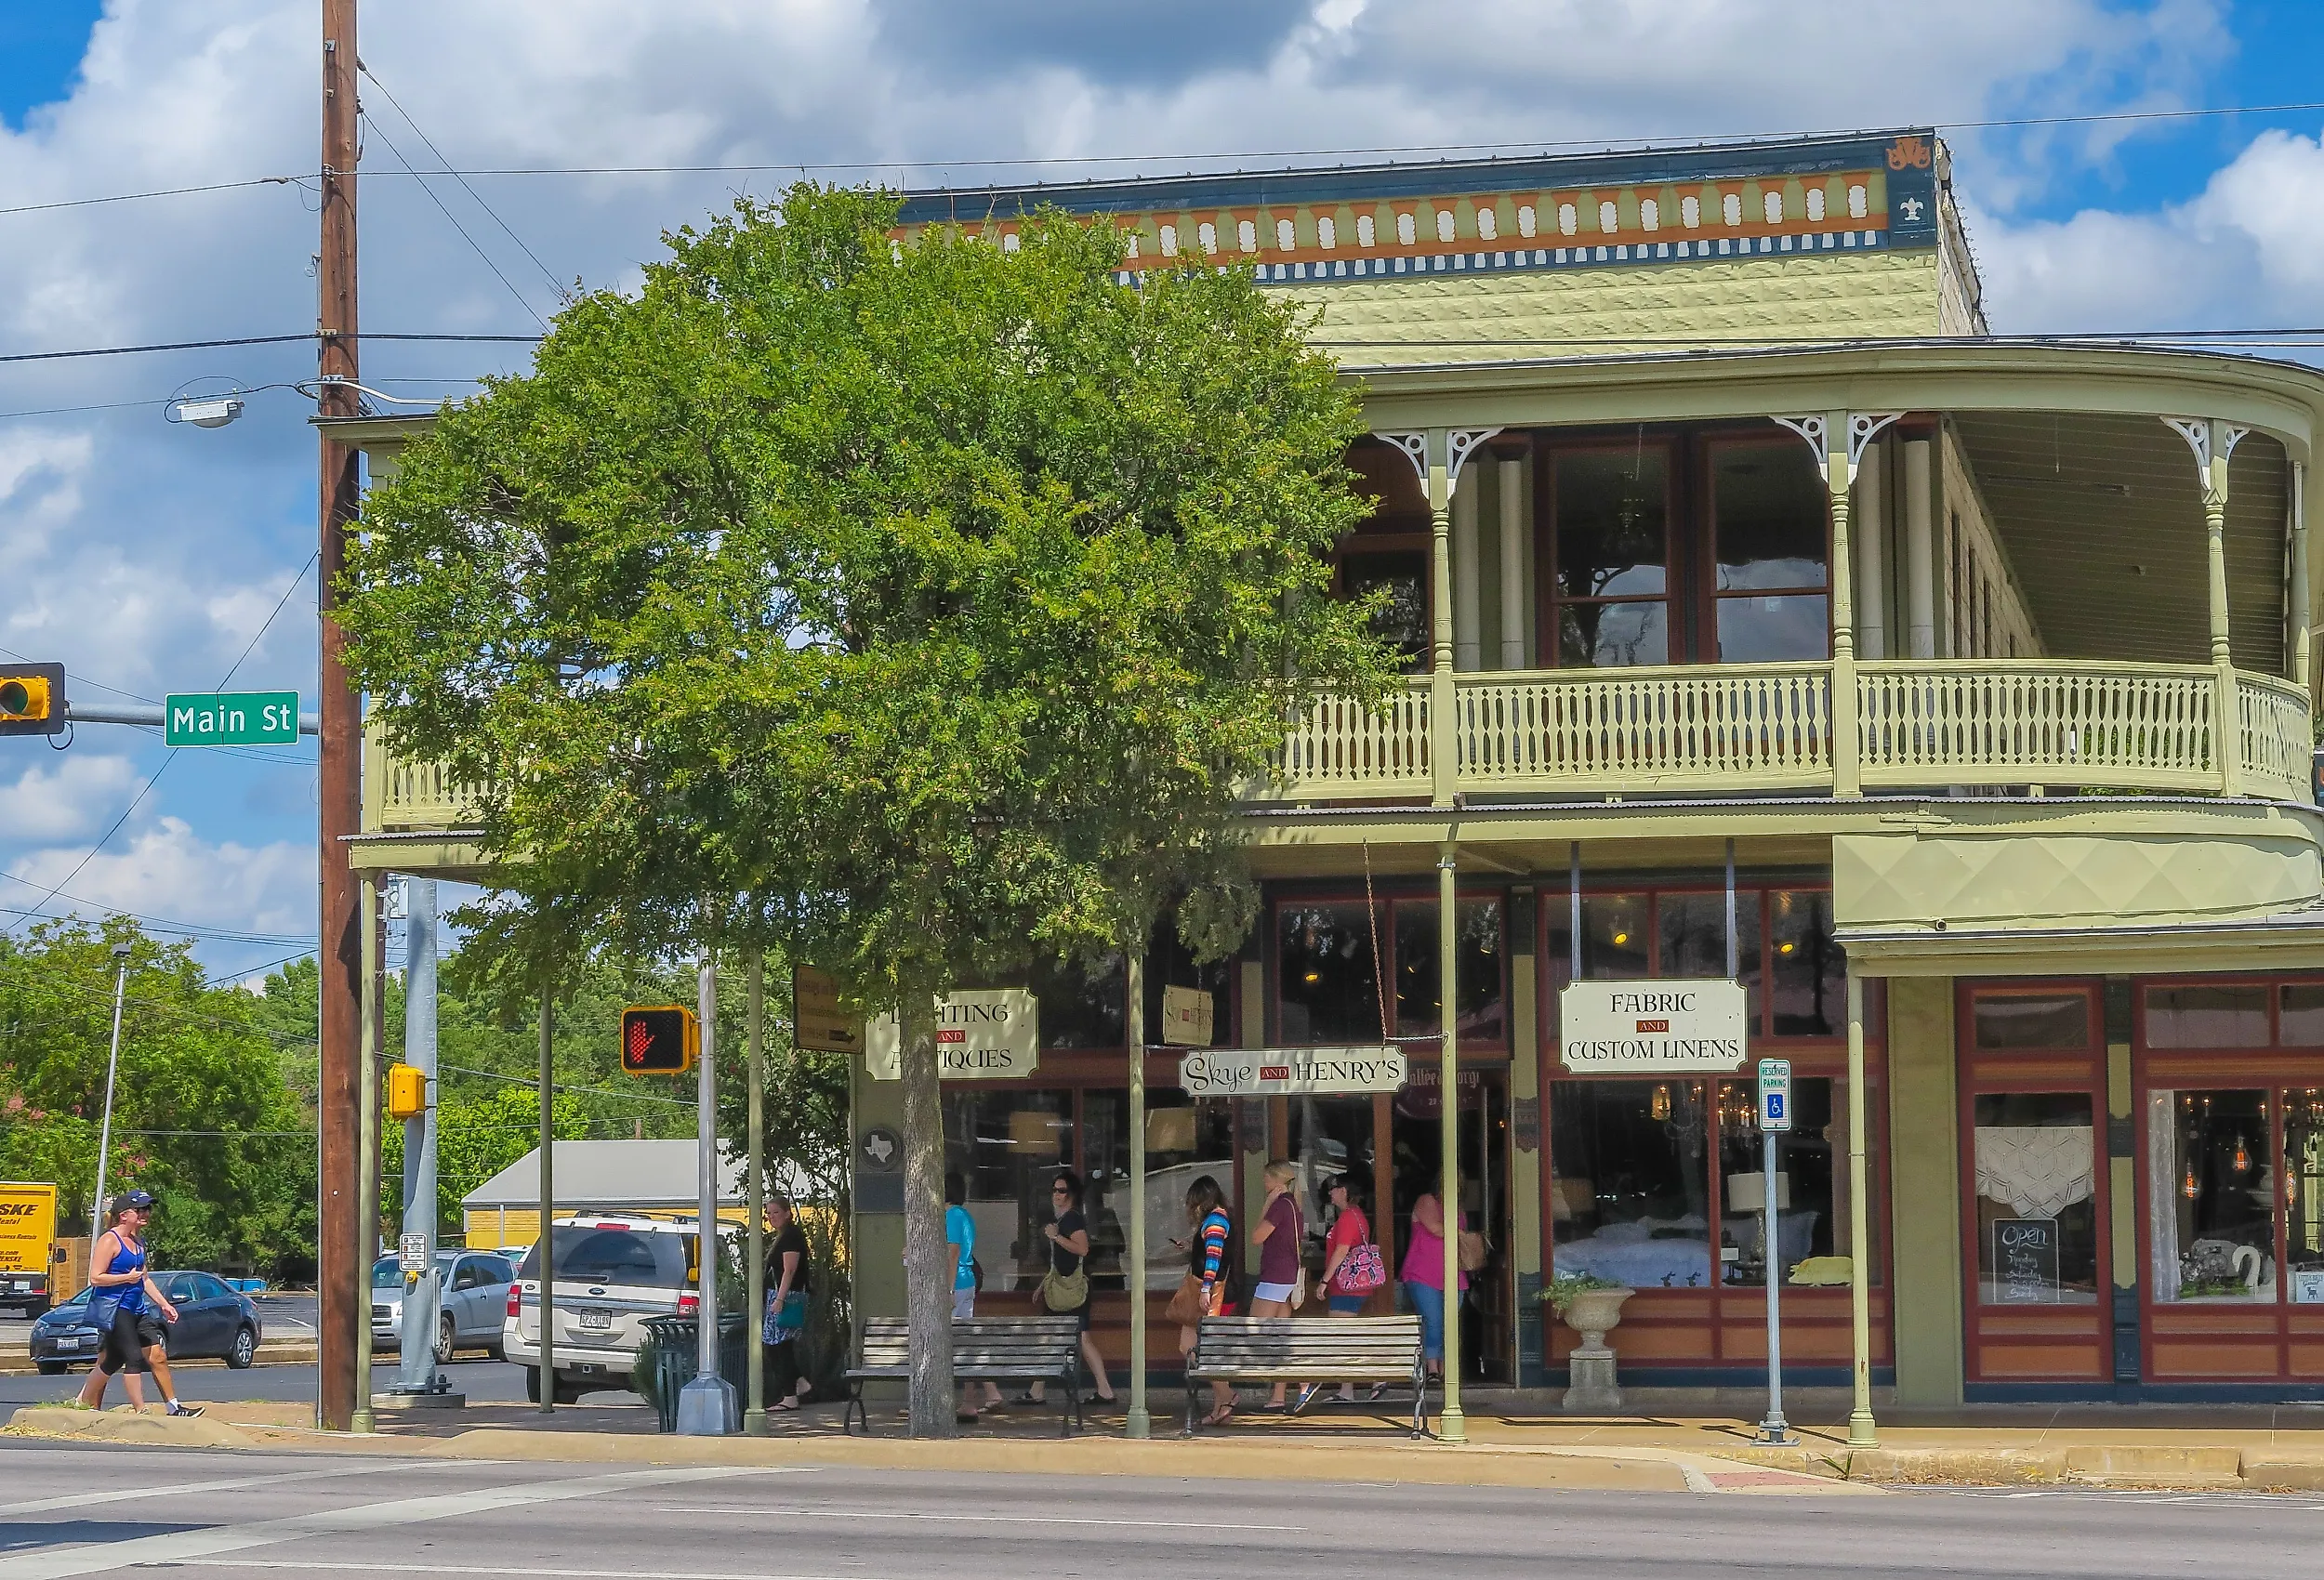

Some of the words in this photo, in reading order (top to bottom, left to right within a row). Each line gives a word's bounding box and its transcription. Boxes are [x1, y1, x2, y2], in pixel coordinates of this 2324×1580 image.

[173, 704, 245, 733] Main
[261, 704, 291, 731] St
[1609, 992, 1697, 1013] FABRIC
[938, 1033, 962, 1041] AND
[1639, 1021, 1666, 1032] AND
[1567, 1039, 1655, 1061] CUSTOM
[1662, 1038, 1739, 1060] LINENS
[1185, 1053, 1252, 1093] Skye
[1261, 1069, 1288, 1079] AND
[1296, 1059, 1400, 1084] HENRY'S
[1762, 1067, 1788, 1076] RESERVED
[1763, 1078, 1787, 1087] PARKING
[2002, 1226, 2049, 1255] Open
